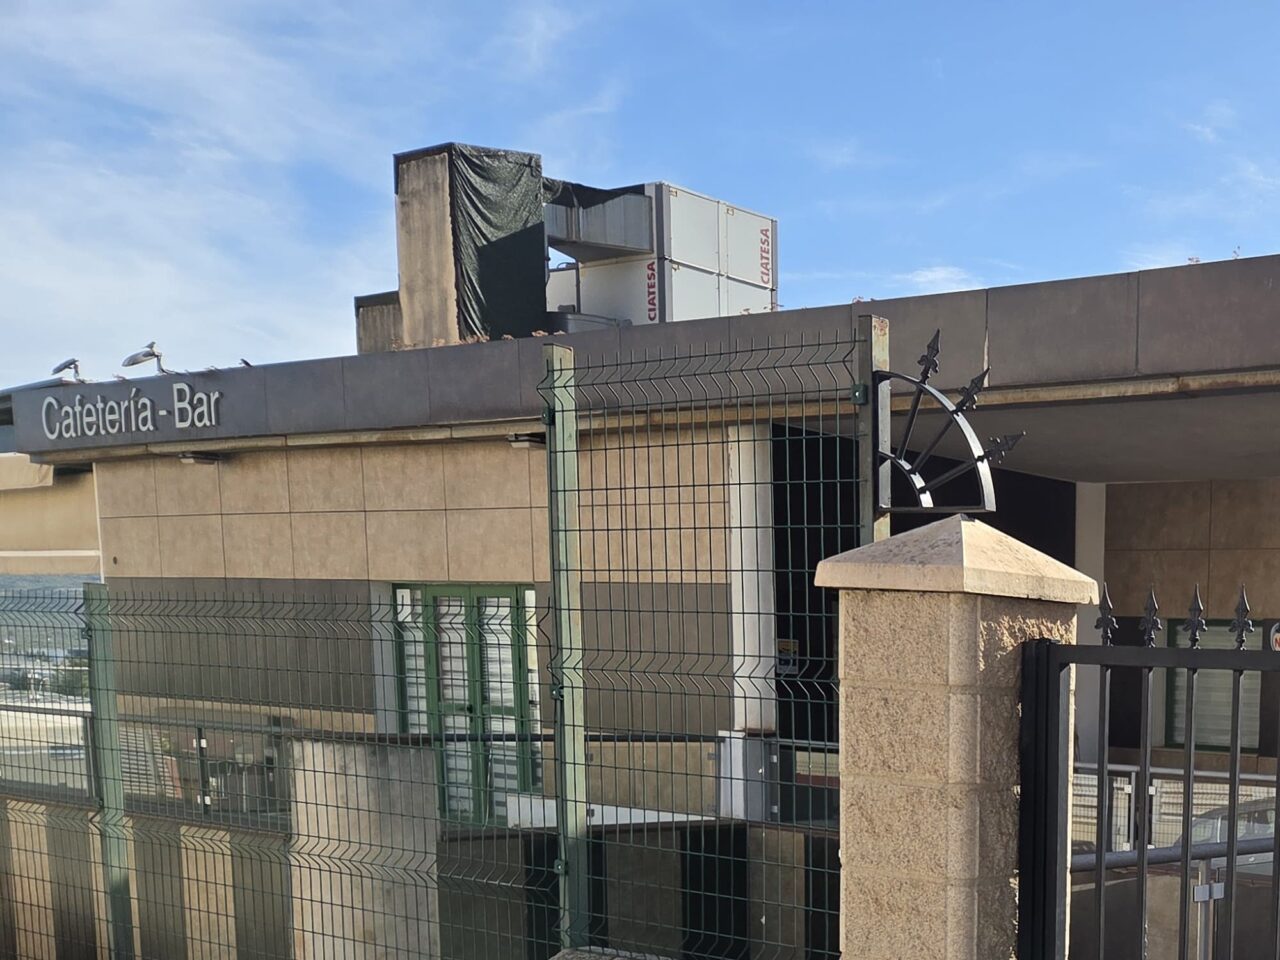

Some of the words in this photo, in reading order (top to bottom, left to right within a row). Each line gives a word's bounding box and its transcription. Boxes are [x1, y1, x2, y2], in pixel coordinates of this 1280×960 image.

[759, 228, 770, 285] CIATESA
[647, 261, 657, 322] CIATESA
[42, 388, 153, 440] Cafetería
[173, 383, 219, 429] Bar
